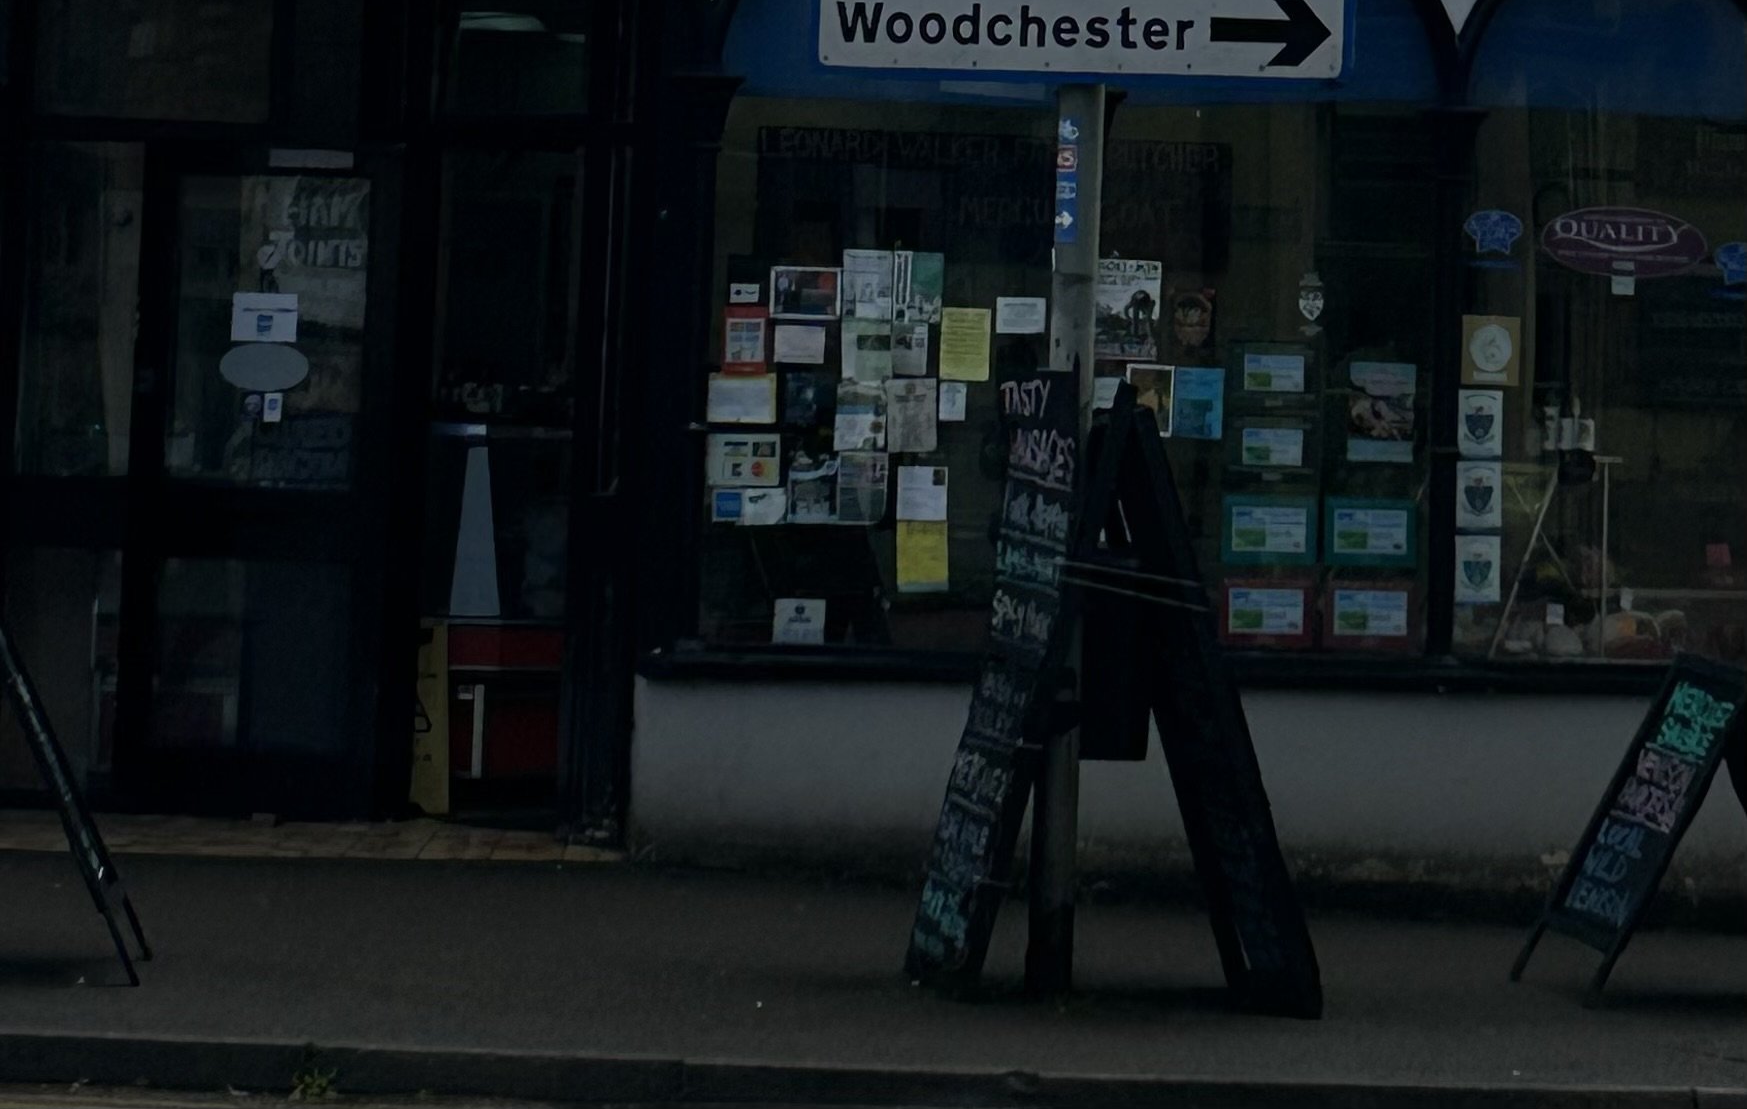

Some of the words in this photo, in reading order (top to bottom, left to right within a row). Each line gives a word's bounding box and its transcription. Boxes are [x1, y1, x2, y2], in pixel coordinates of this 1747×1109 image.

[836, 0, 1195, 51] Woodchester
[1554, 217, 1679, 246] QUALITY
[1000, 378, 1051, 420] TASTY
